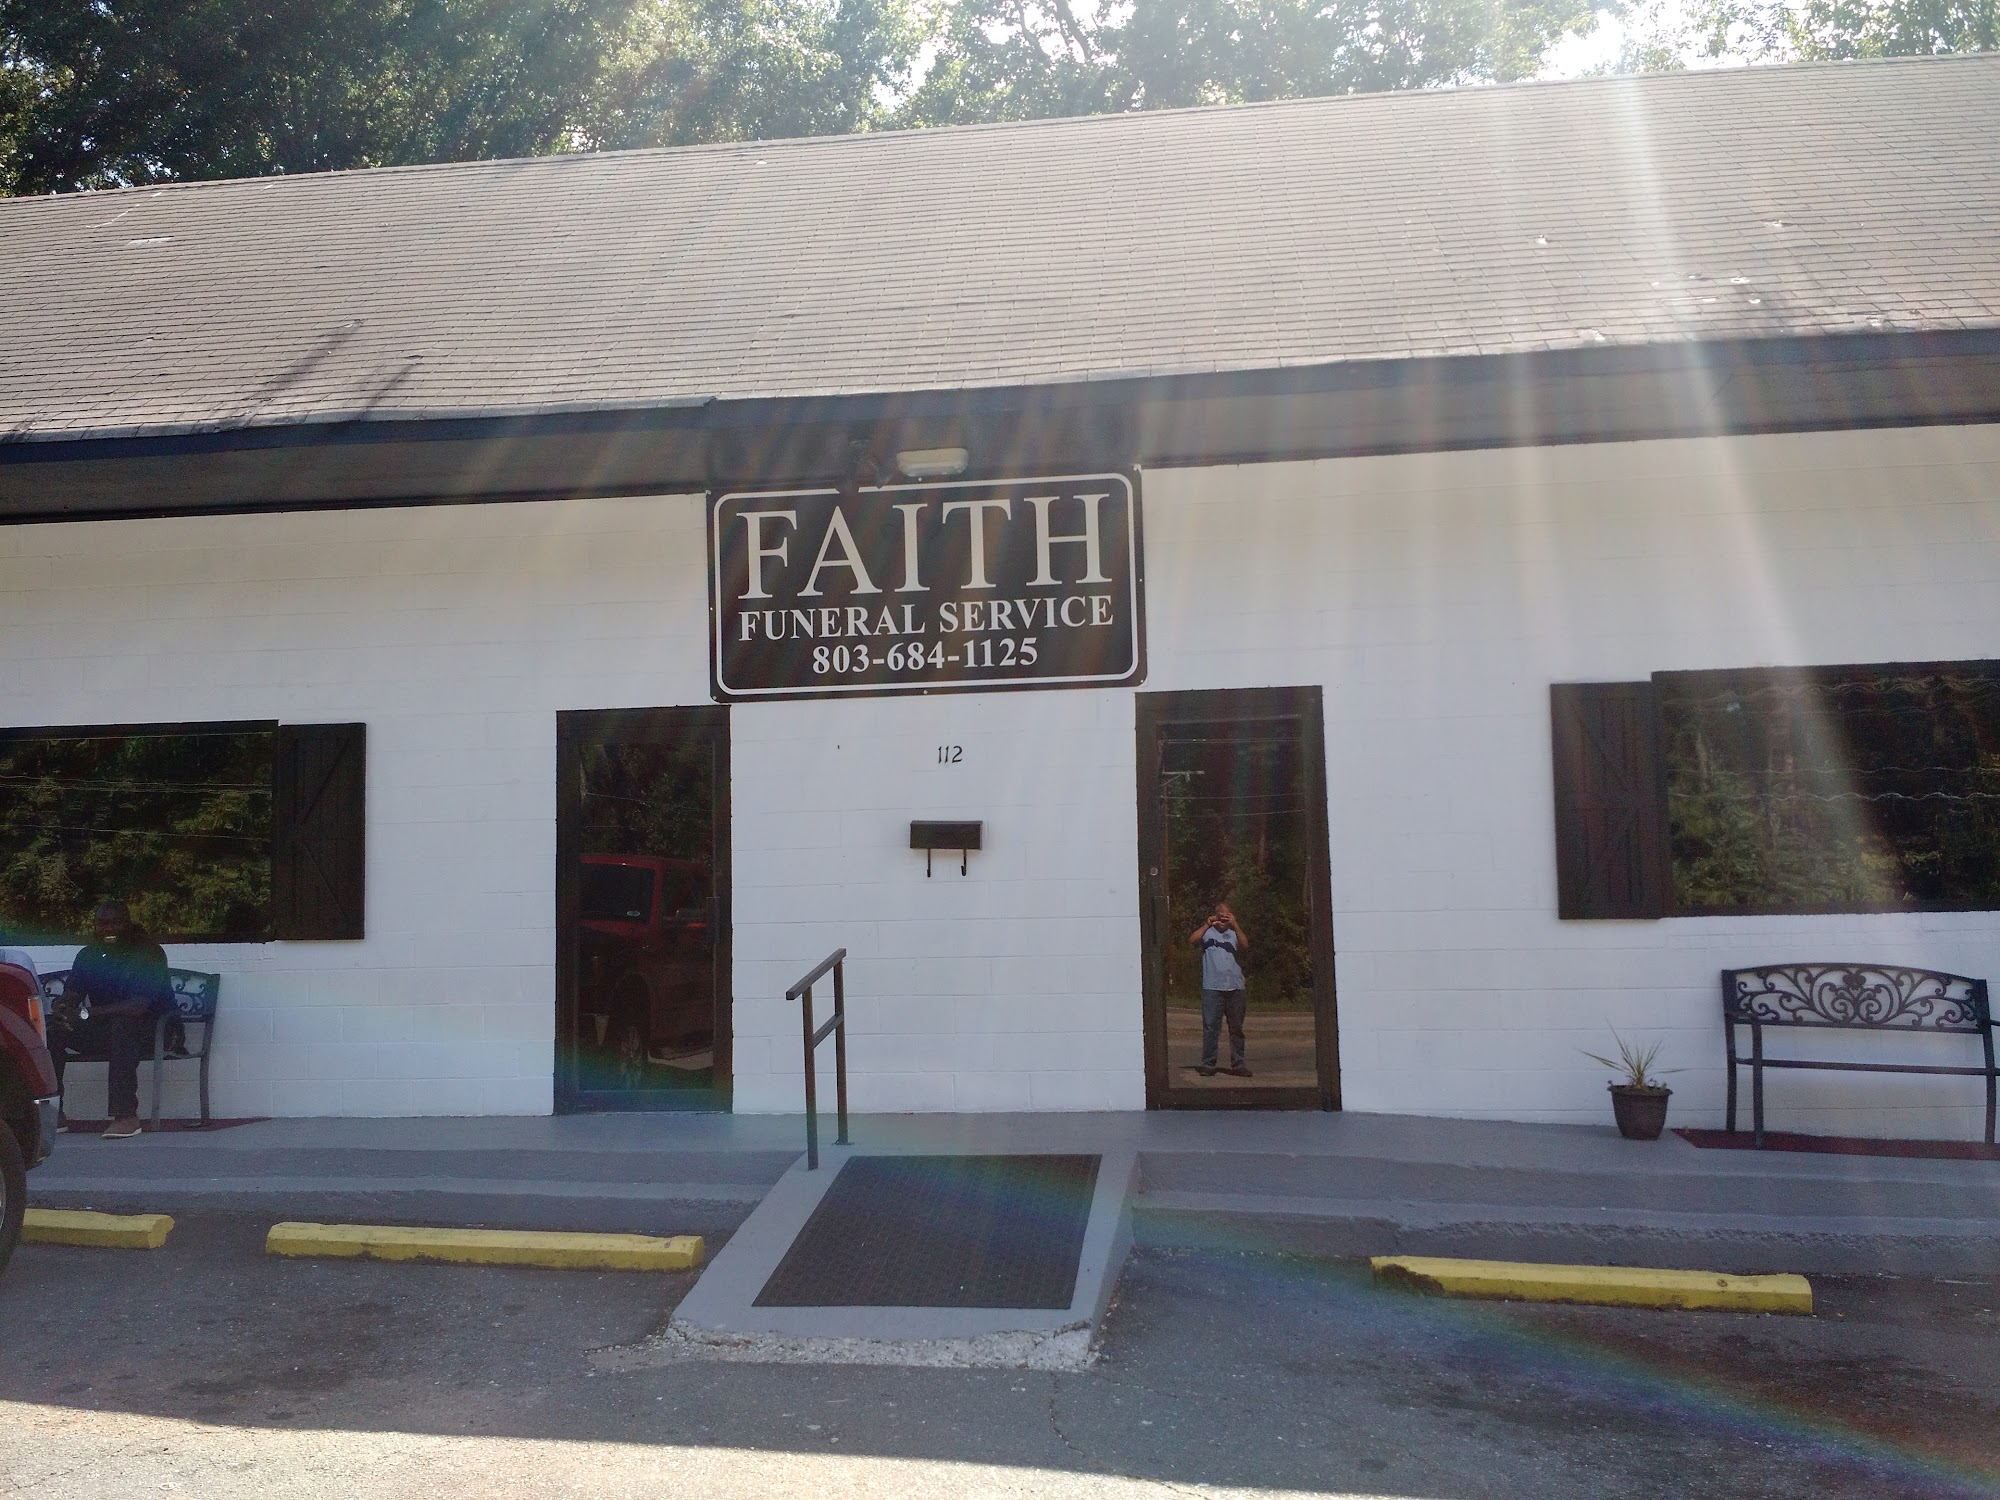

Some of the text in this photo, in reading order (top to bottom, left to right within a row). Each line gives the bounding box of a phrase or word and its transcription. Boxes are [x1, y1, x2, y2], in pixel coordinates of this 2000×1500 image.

[736, 493, 1113, 600] FAITH
[738, 595, 1114, 642] FUNERAL SERVICE
[812, 637, 1038, 674] 803-684-1125
[937, 745, 963, 764] 112
